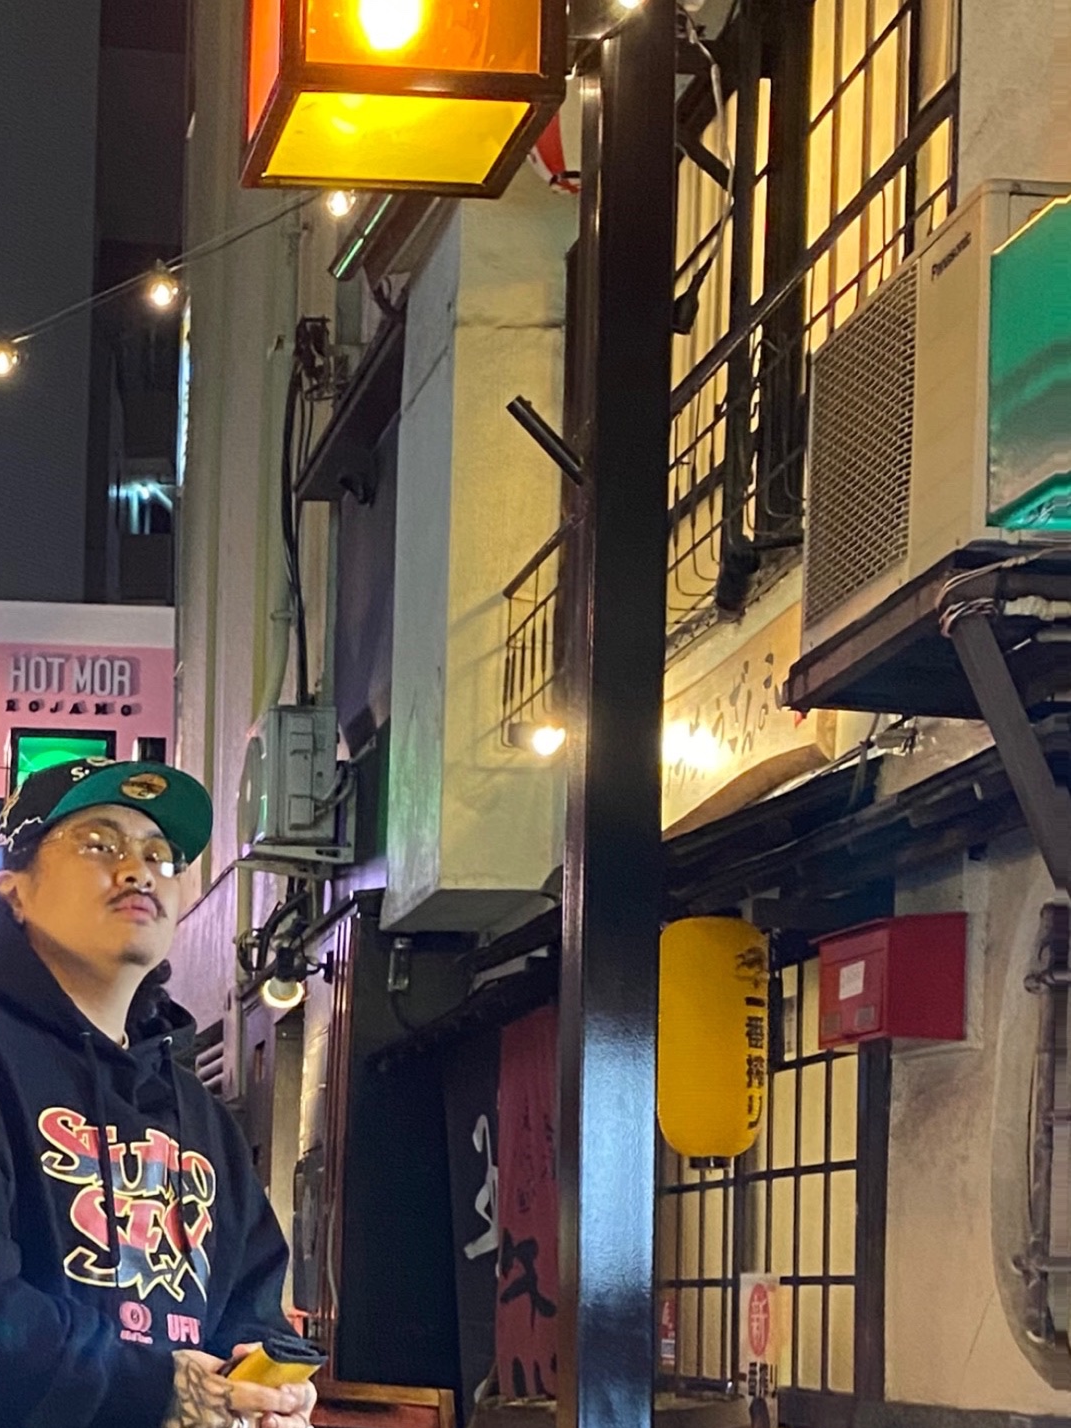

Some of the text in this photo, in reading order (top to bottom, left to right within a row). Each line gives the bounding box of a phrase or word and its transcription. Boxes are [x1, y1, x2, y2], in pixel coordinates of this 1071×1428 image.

[11, 656, 132, 697] HOT MOR
[6, 699, 132, 717] ROJAMO
